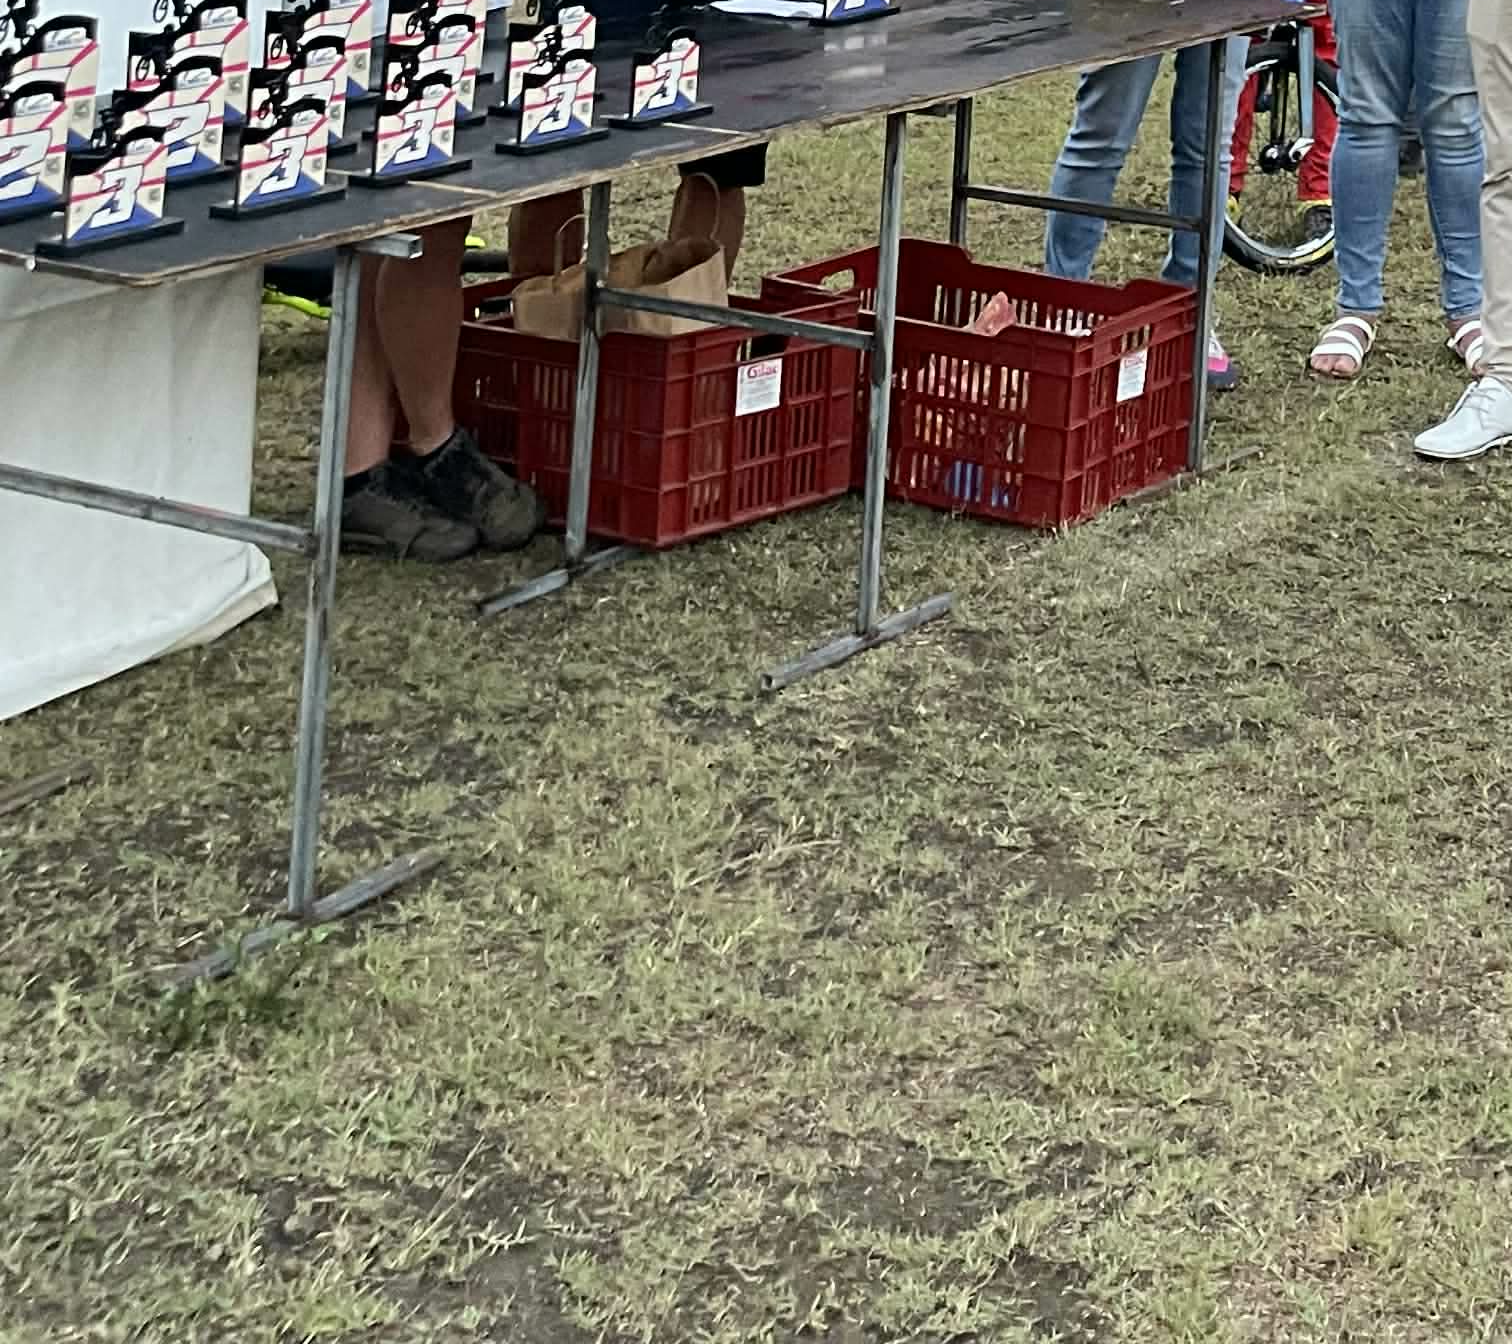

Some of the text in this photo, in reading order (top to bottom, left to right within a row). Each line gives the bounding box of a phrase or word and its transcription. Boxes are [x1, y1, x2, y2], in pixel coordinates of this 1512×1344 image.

[393, 107, 438, 164] 3
[538, 81, 579, 135] 3
[259, 134, 309, 194] 3
[90, 163, 145, 229] 3
